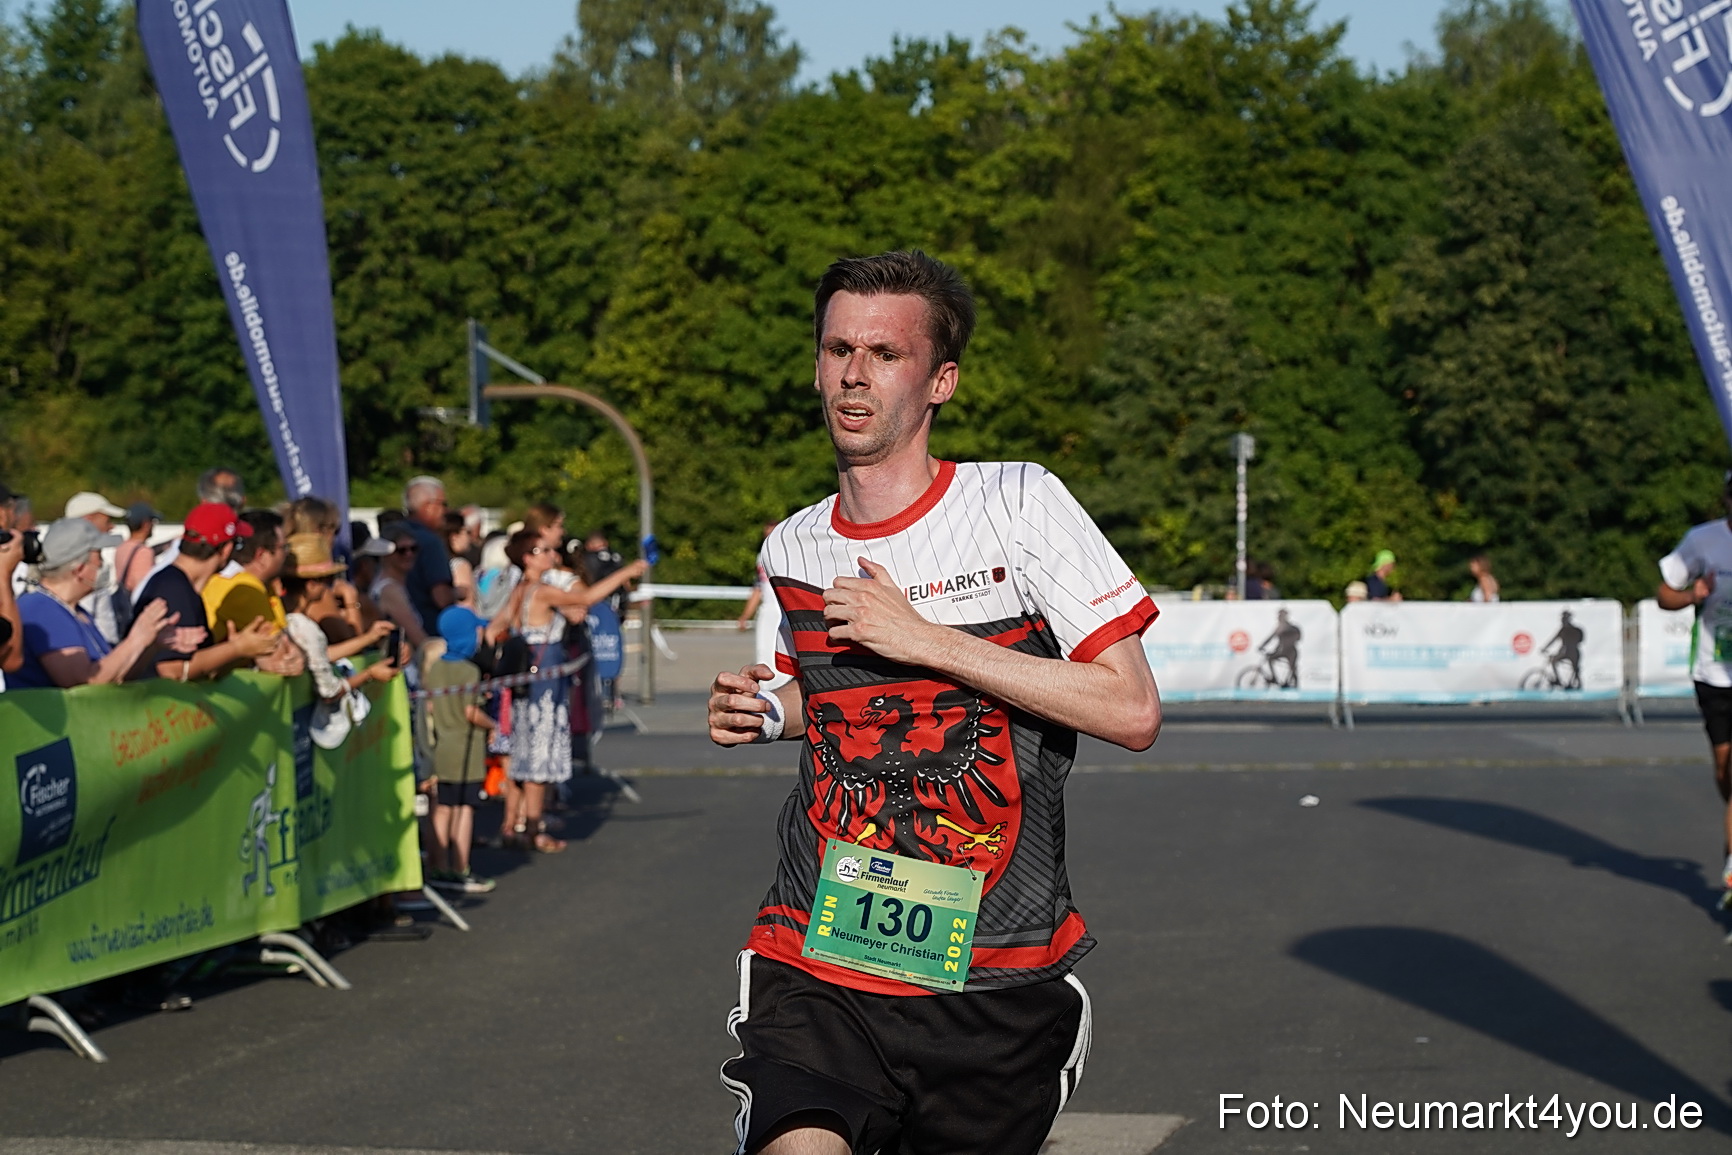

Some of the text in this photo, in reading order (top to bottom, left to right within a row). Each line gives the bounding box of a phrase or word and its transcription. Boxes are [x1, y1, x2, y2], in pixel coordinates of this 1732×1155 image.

[951, 590, 991, 603] STARKE STADT
[0, 815, 117, 923] rmenlauf
[860, 872, 909, 888] Firmenlauf
[877, 883, 907, 893] neumarkt
[817, 894, 839, 937] RUN
[855, 892, 933, 942] 130
[831, 926, 945, 962] Neumeyer Christian
[864, 954, 902, 968] Stadt Neumarkt
[944, 918, 968, 973] 2022
